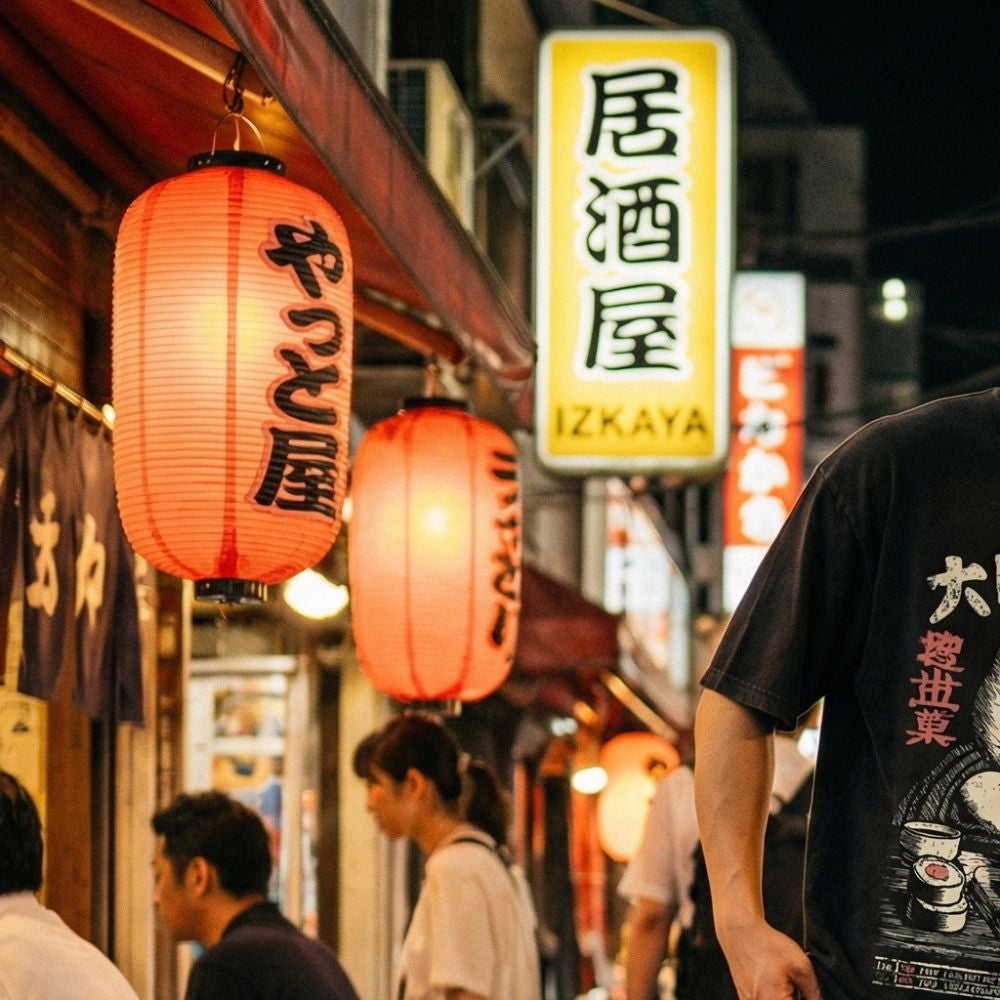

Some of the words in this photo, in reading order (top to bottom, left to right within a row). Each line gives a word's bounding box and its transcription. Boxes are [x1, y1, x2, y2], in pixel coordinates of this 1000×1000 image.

[586, 68, 682, 371] 居酒屋
[556, 405, 709, 437] IZKAYA
